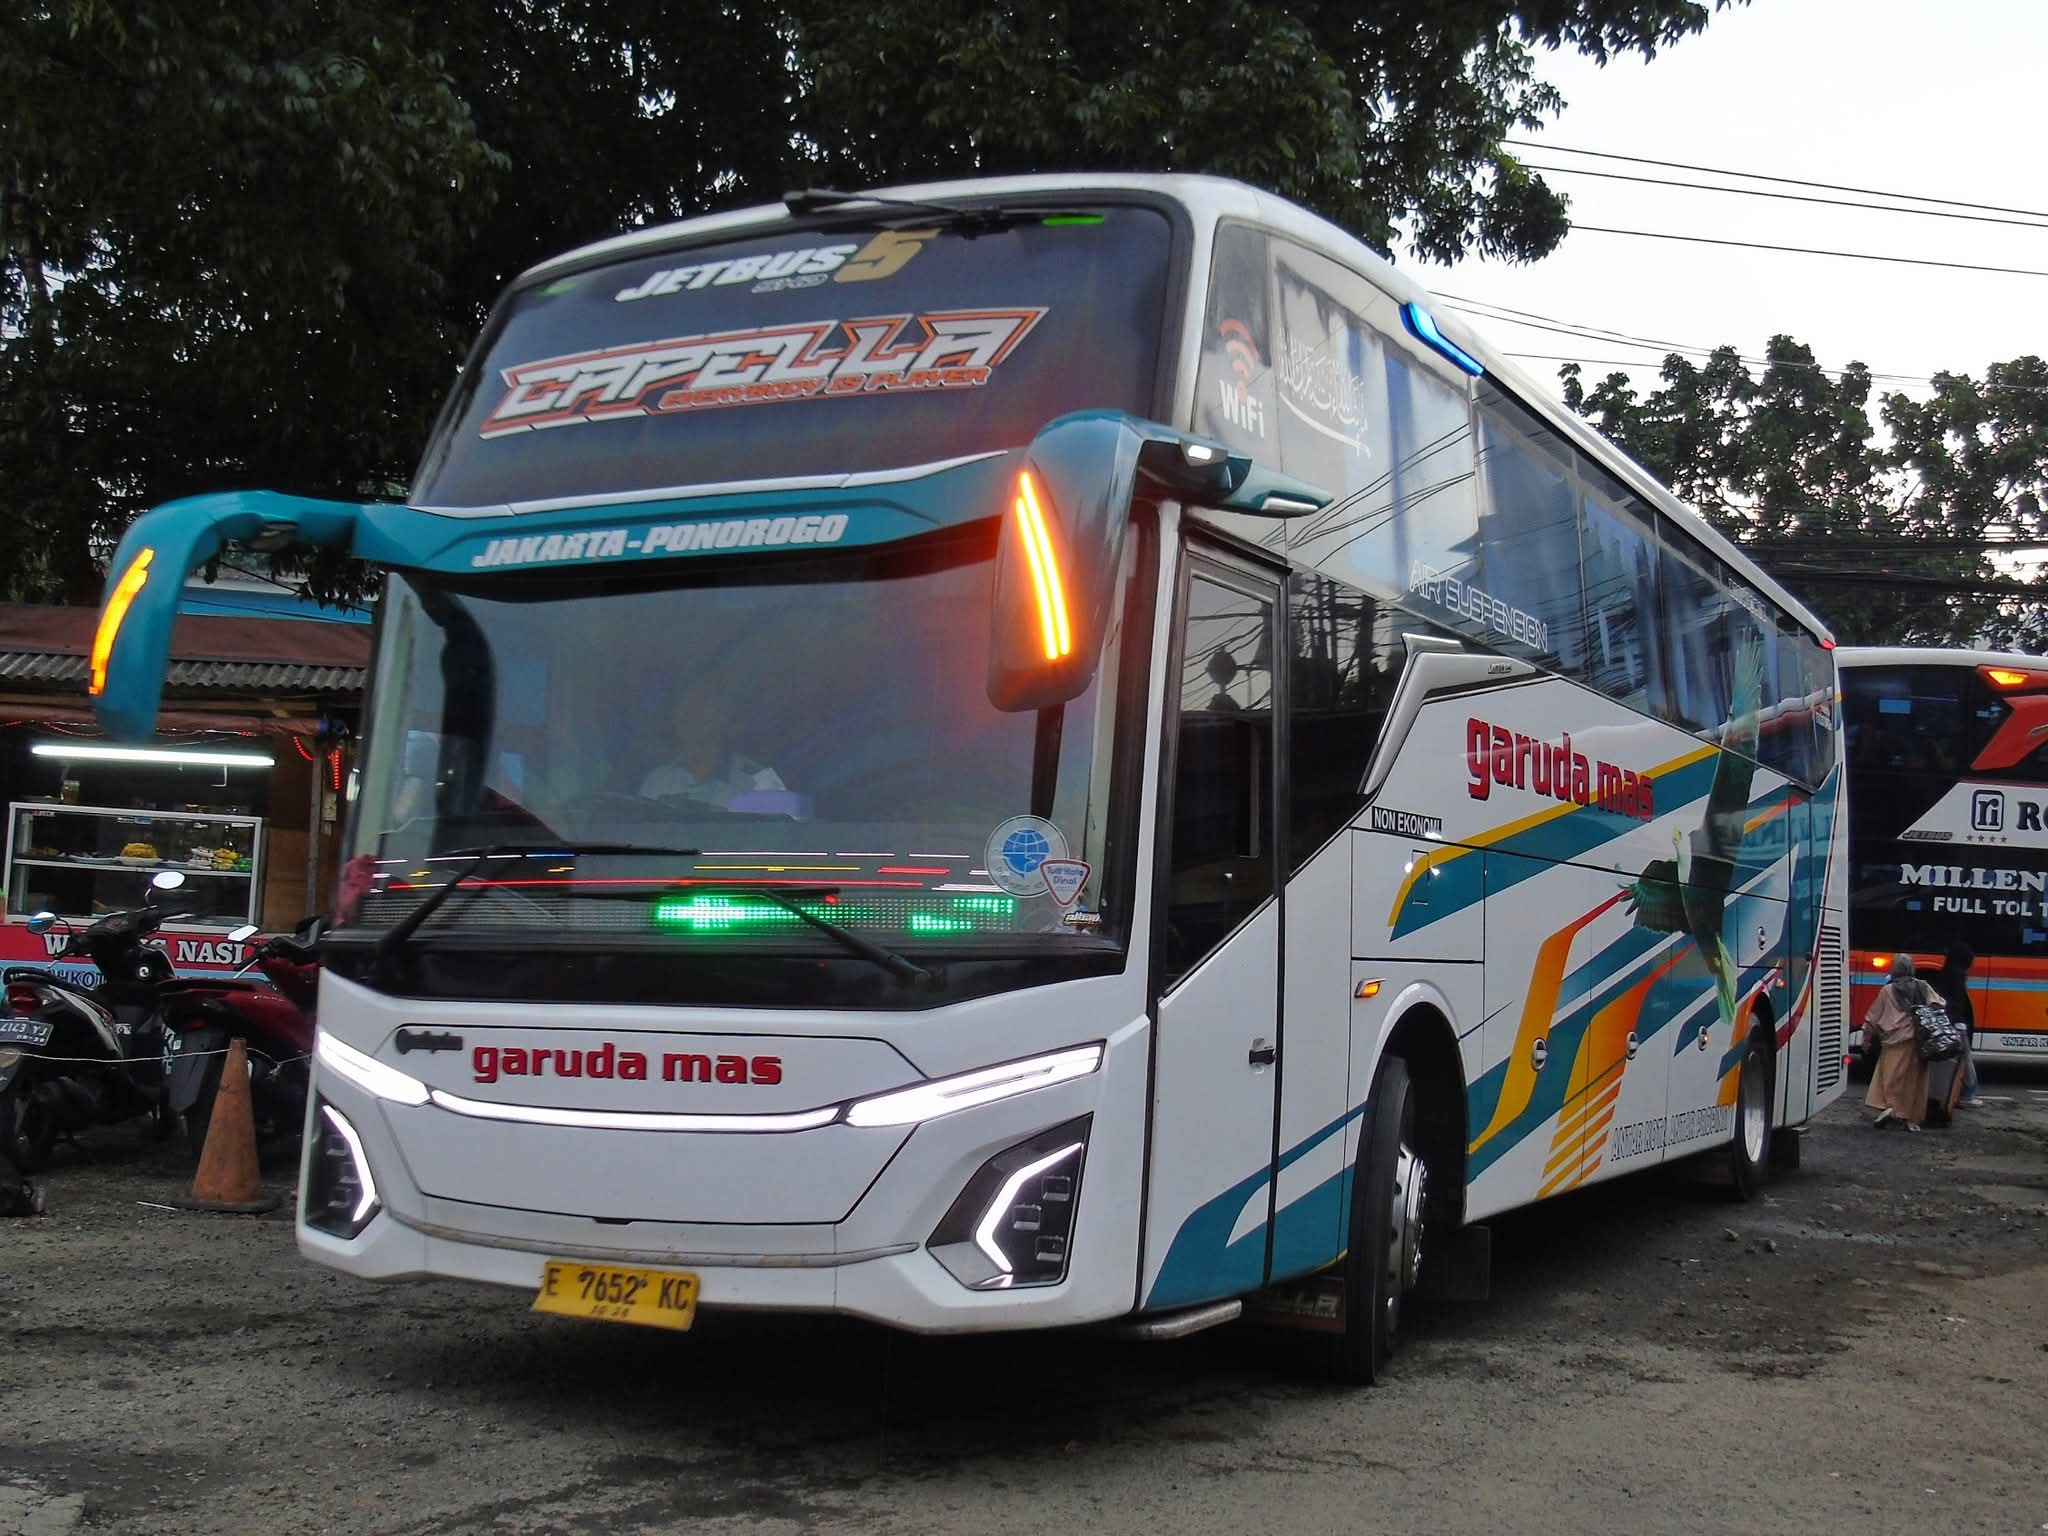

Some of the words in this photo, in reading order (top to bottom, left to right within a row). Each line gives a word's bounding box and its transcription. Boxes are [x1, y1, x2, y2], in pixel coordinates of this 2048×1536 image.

[614, 244, 859, 302] JETBUS
[834, 227, 944, 284] 5
[488, 312, 1035, 425] CAPELLA
[1410, 559, 1442, 605] AIR
[1466, 717, 1590, 806] garuda
[1596, 760, 1654, 822] mas
[1374, 807, 1396, 831] NON
[1397, 813, 1442, 837] EKONOMI
[1933, 897, 1987, 915] FULL
[1992, 900, 2033, 917] TOL
[176, 940, 245, 964] NASI
[472, 1042, 647, 1083] garuda
[662, 1050, 783, 1086] mas
[546, 1267, 561, 1297] E
[577, 1270, 638, 1306] 7652
[658, 1278, 692, 1311] KC
